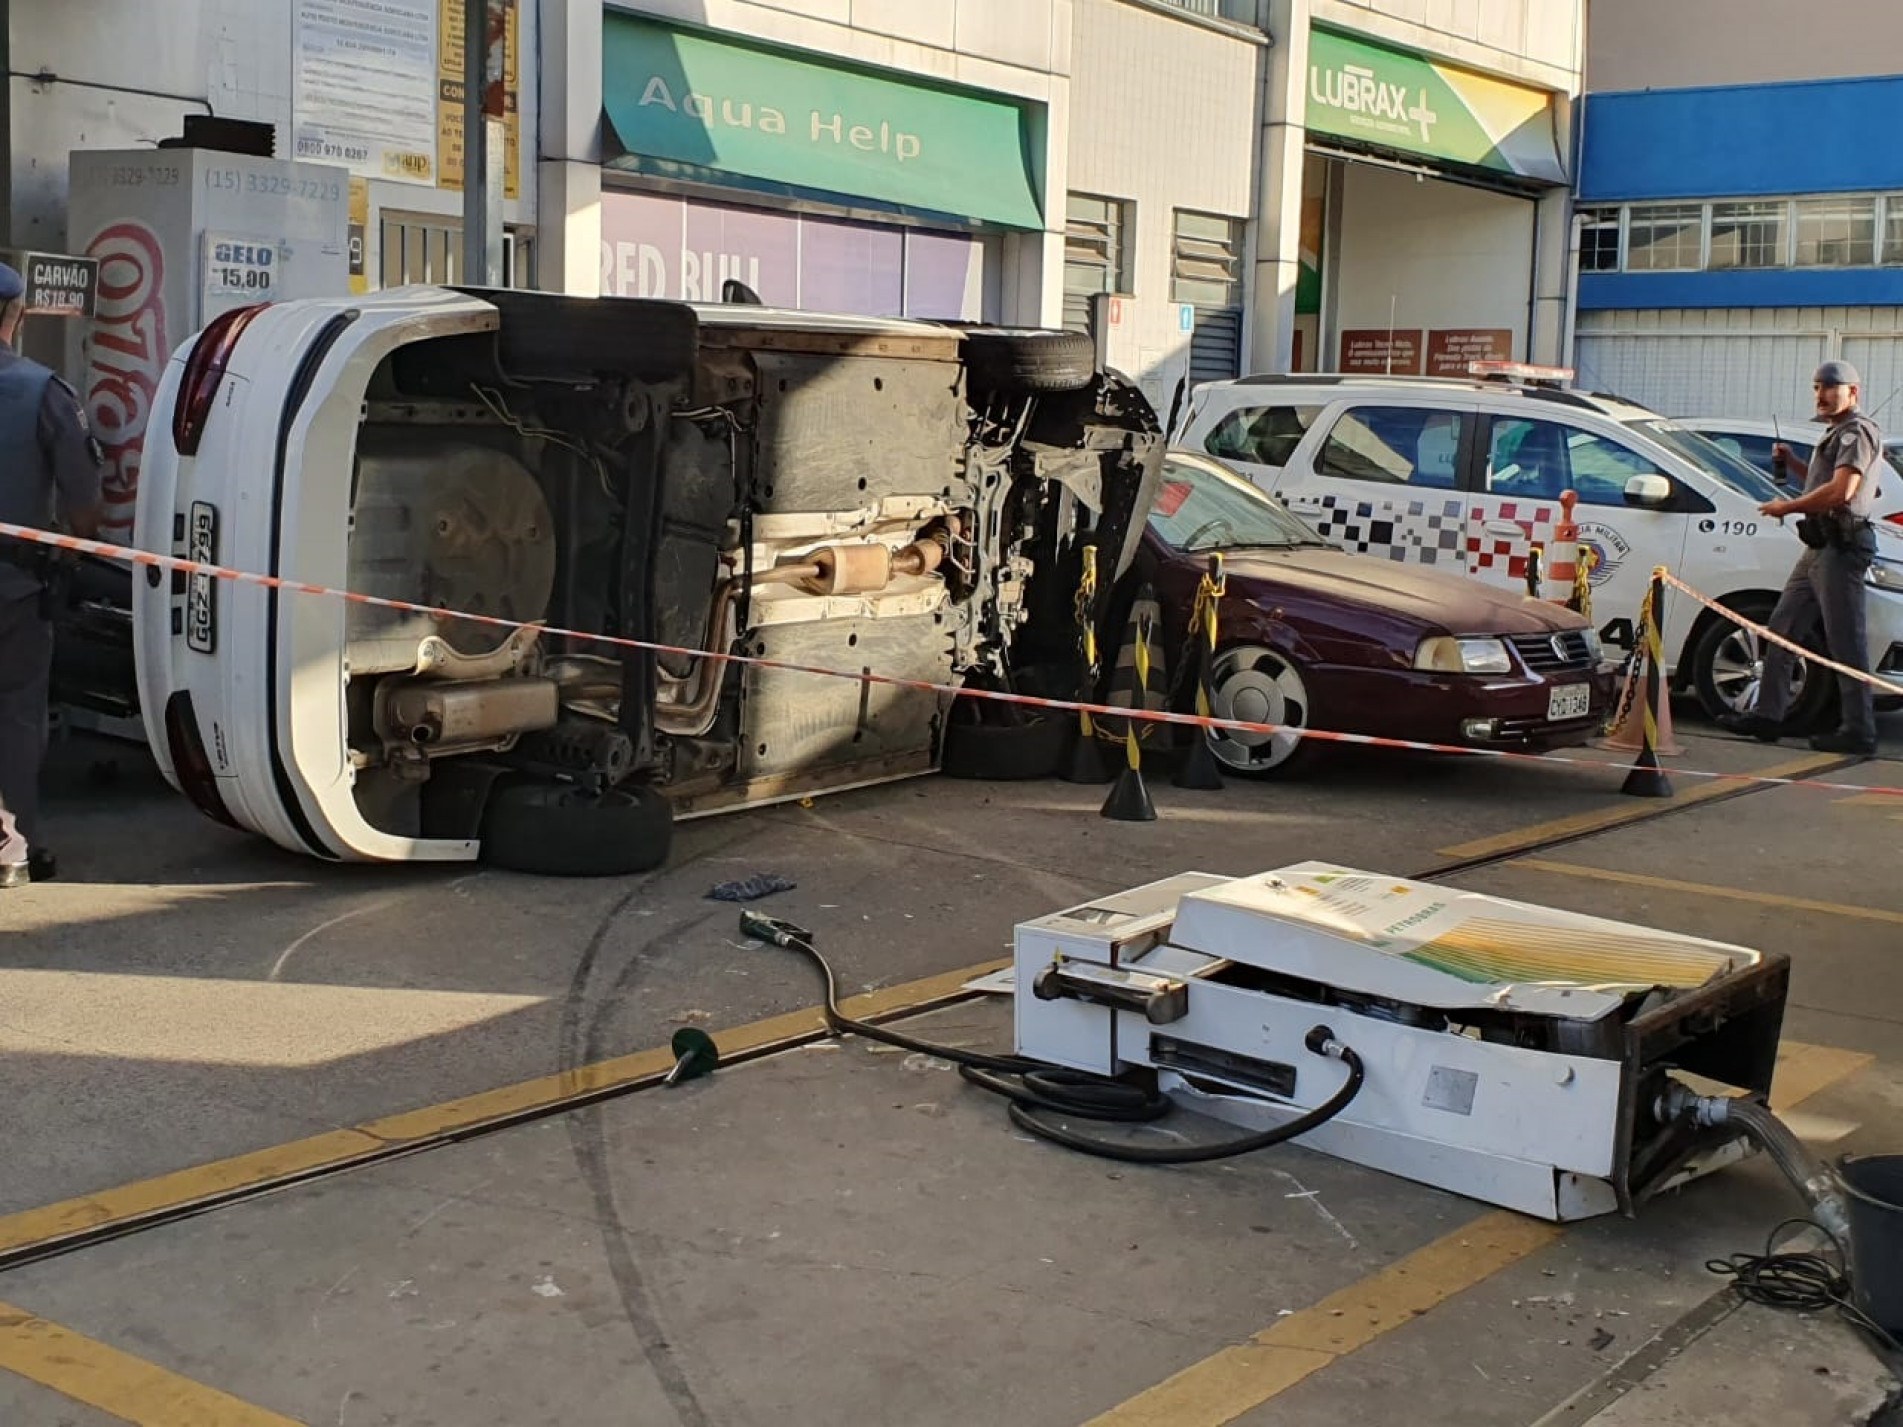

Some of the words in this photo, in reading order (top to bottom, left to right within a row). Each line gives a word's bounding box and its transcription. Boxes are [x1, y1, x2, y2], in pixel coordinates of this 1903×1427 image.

[638, 76, 786, 134] Aqua
[810, 108, 921, 161] Help
[205, 168, 241, 193] (15)
[215, 243, 273, 267] GELO
[34, 262, 89, 288] CARVÃO
[600, 240, 667, 298] RED
[1721, 520, 1759, 536] 190
